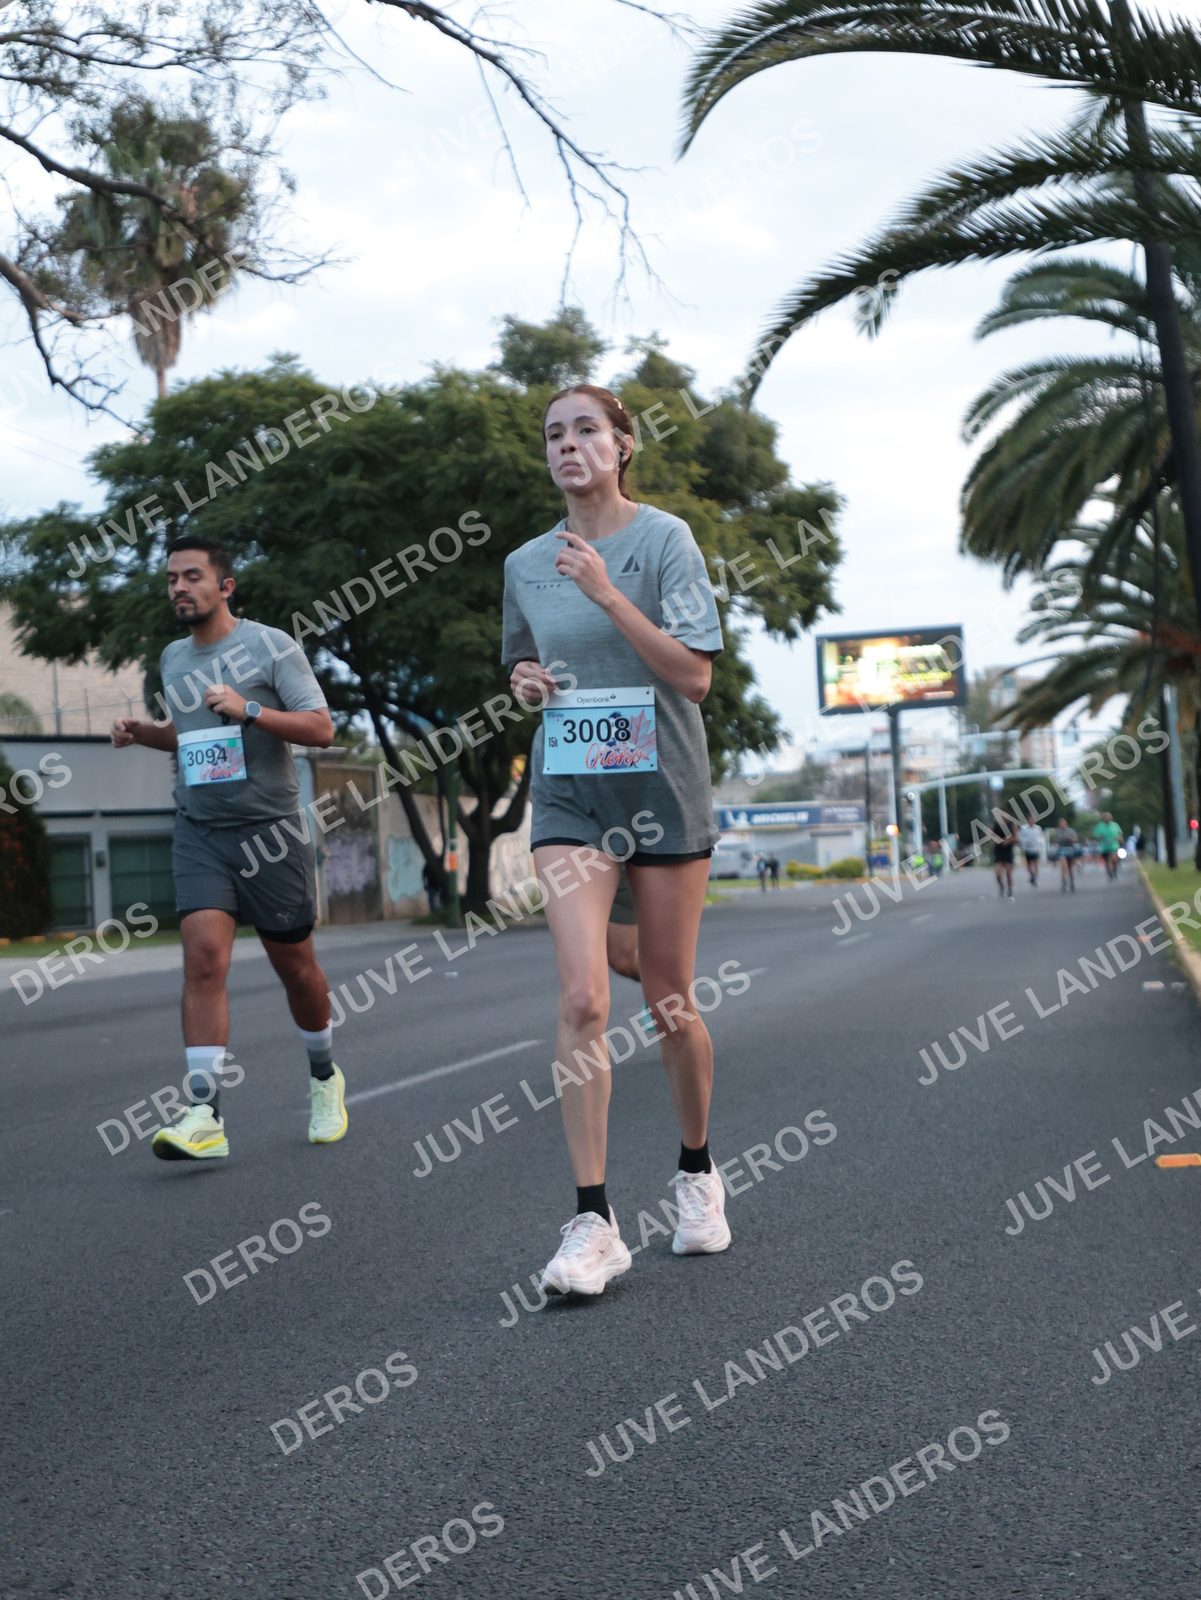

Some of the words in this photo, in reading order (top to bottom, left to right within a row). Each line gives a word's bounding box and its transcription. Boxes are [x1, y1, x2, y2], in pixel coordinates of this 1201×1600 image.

[577, 696, 609, 704] Openbank
[563, 717, 631, 743] 3008
[186, 747, 228, 767] 3094
